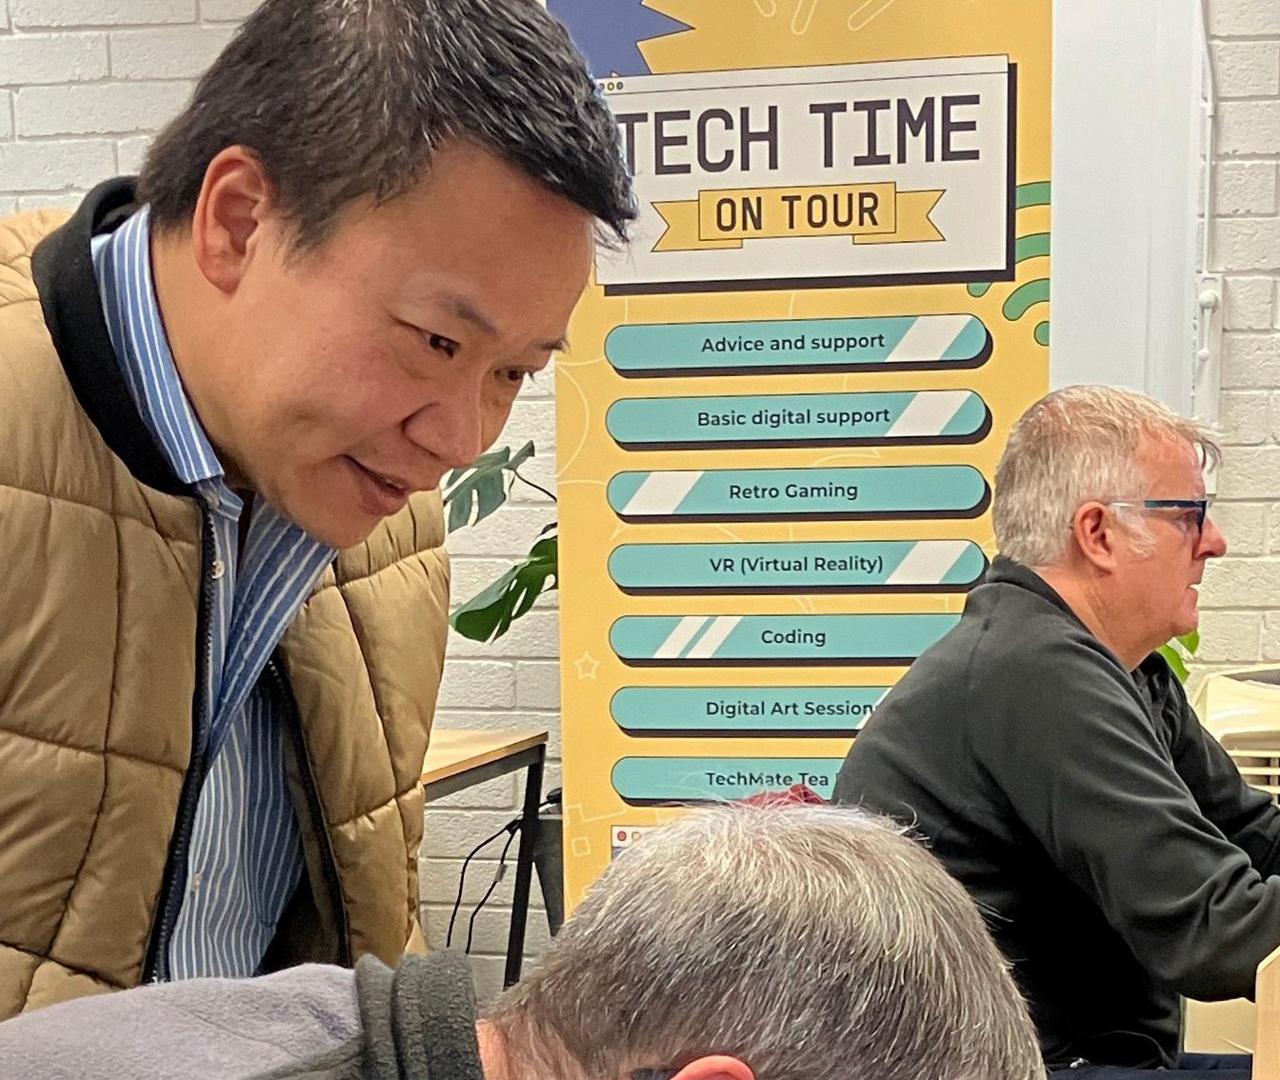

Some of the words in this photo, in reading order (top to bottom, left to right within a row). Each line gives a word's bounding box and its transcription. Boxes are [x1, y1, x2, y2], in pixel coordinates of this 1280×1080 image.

[617, 104, 779, 177] TECH
[809, 94, 981, 168] TIME
[715, 194, 763, 232] ON
[780, 190, 880, 231] TOUR
[701, 333, 765, 353] Advice
[769, 333, 806, 352] and
[810, 331, 886, 354] support
[696, 408, 748, 427] Basic
[751, 407, 812, 429] digital
[816, 407, 891, 429] support
[728, 483, 780, 501] Retro
[784, 481, 859, 503] Gaming
[709, 556, 735, 573] VR
[739, 555, 809, 575] (Virtual
[813, 555, 884, 575] Reality)
[760, 627, 827, 649] Coding
[706, 699, 766, 719] Digital
[770, 700, 800, 716] Art
[803, 699, 874, 716] Session
[705, 771, 794, 787] TechMate
[798, 772, 830, 787] Tea
